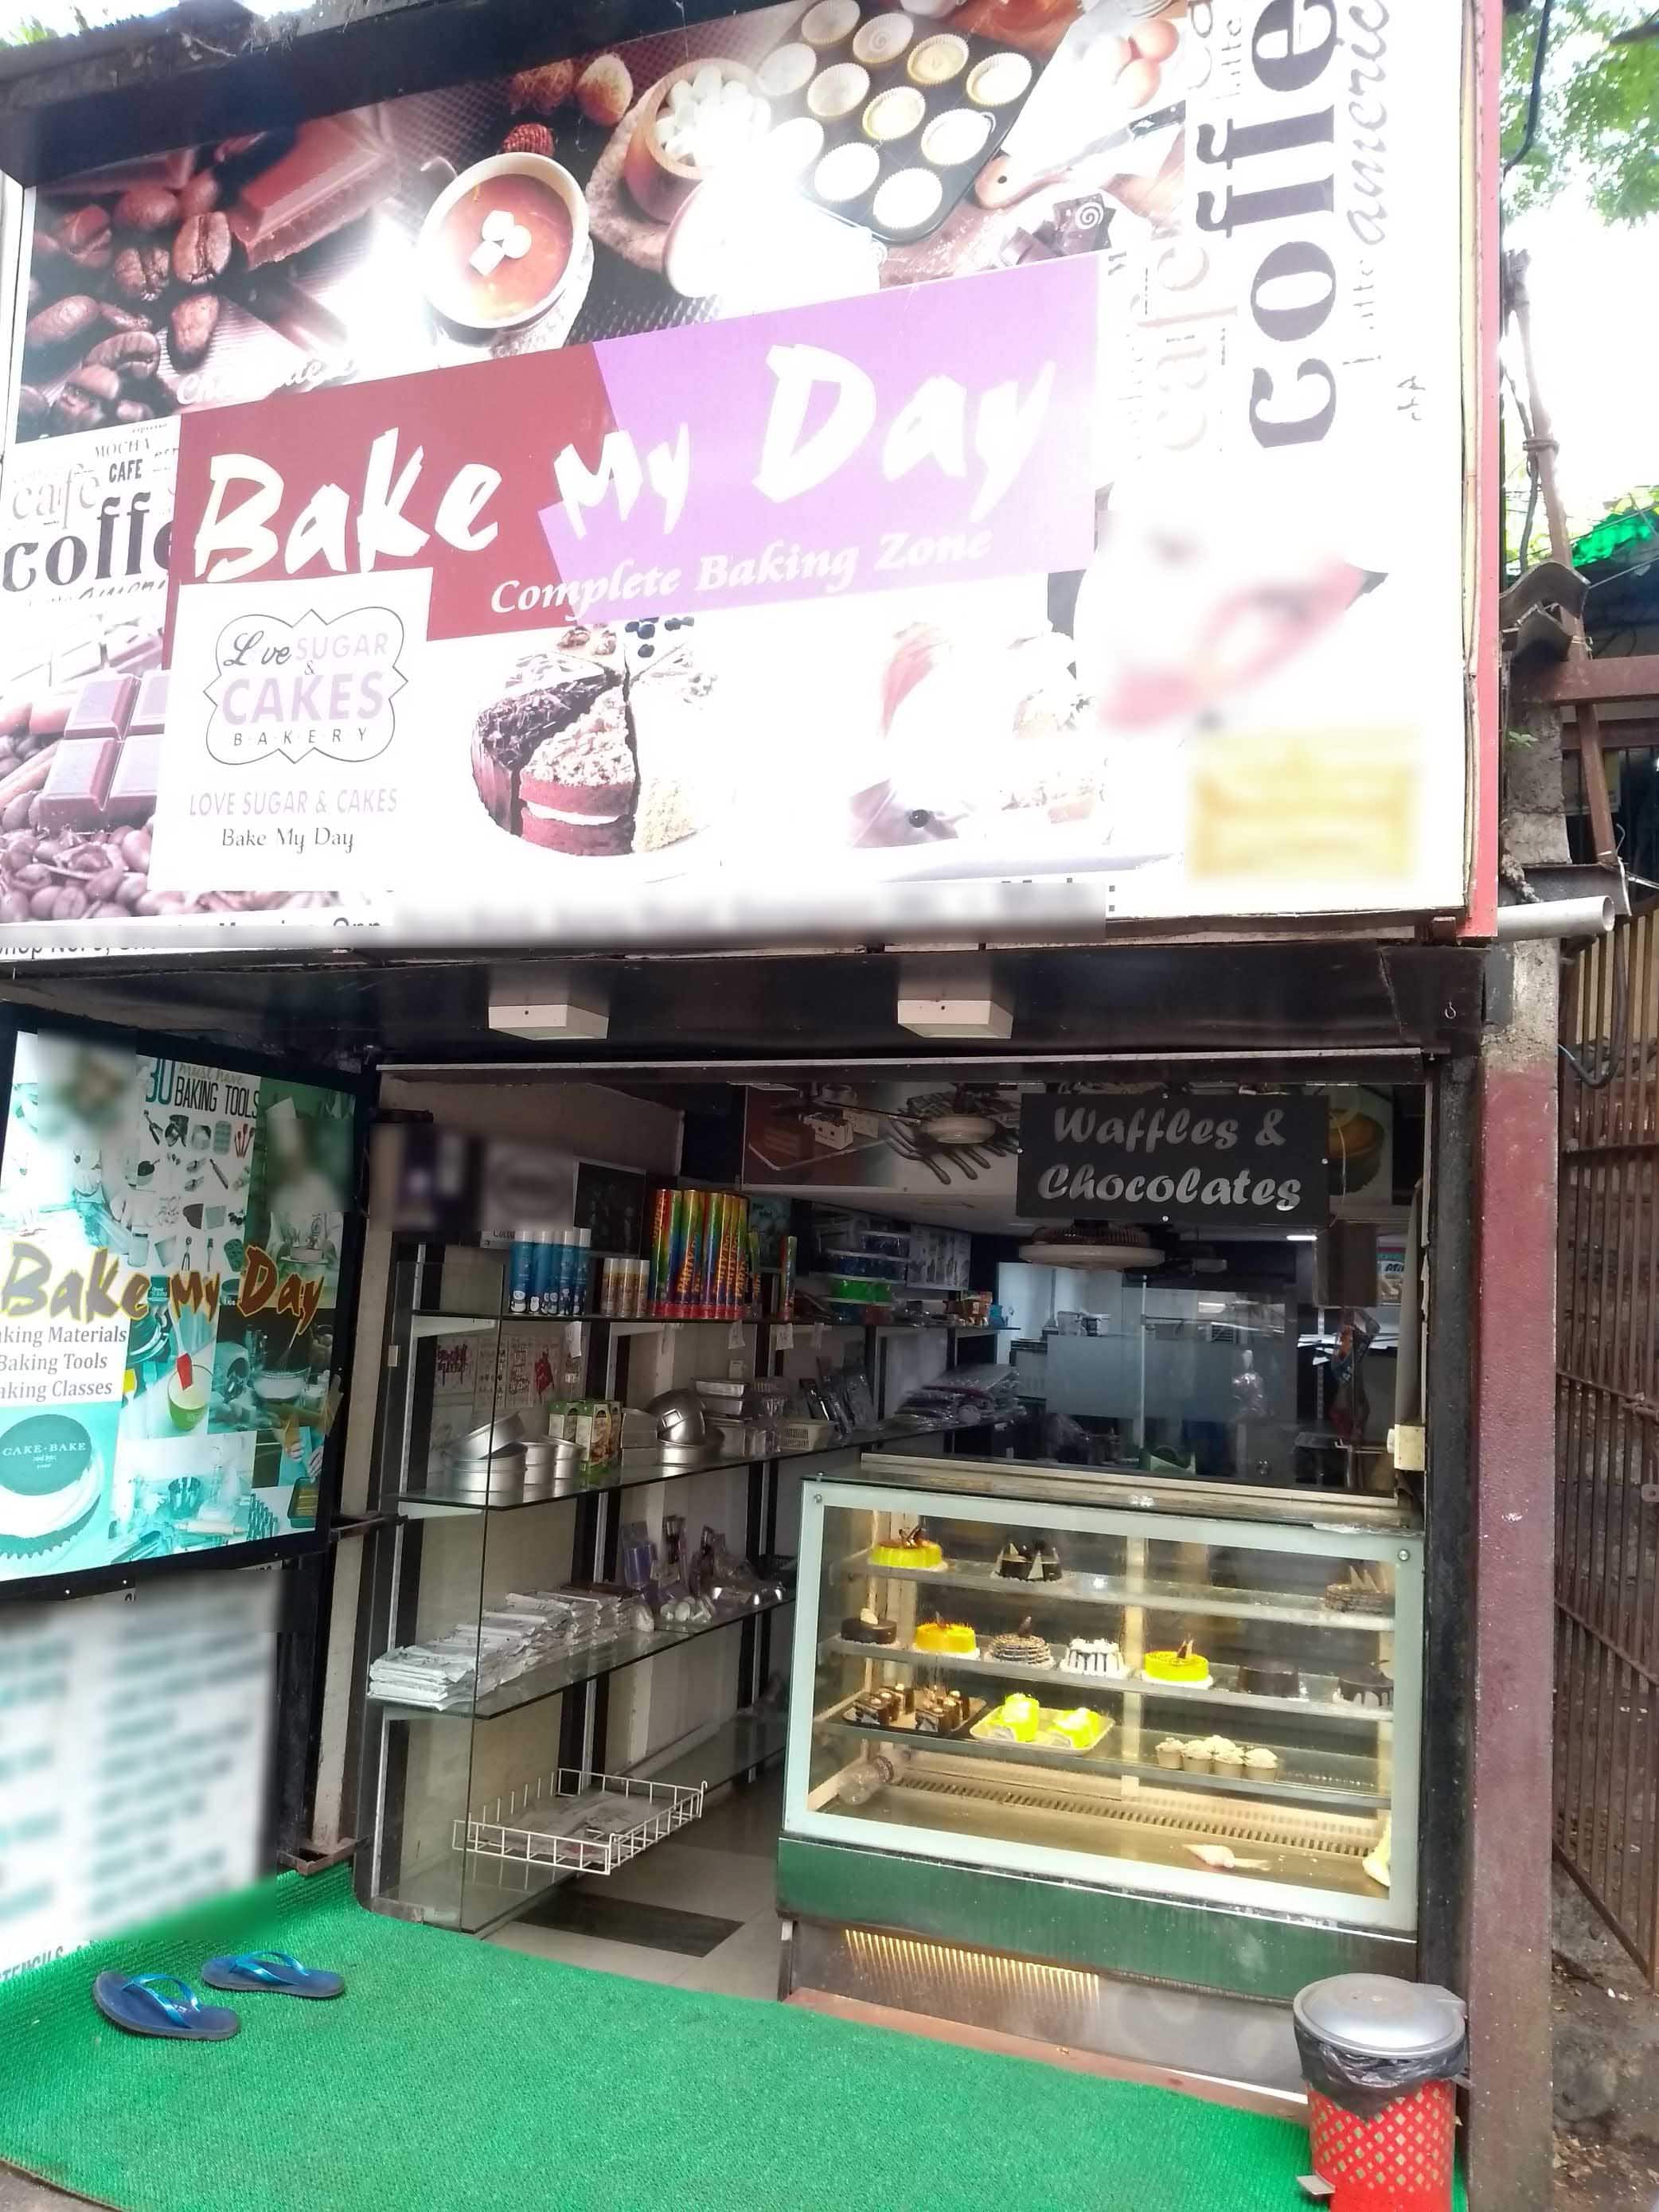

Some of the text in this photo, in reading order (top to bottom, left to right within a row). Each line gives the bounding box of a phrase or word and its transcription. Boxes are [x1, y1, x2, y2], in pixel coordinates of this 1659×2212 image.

[109, 458, 143, 483] CAFE
[193, 427, 502, 582] Bake
[553, 423, 690, 540] My
[751, 343, 1056, 524] Day
[490, 528, 993, 621] Complete Baking Zone
[223, 630, 388, 666] Lve SUGAR
[304, 660, 315, 675] &
[222, 671, 384, 725] CAKES
[189, 788, 397, 816] LOVE SUGAR & CAKES
[222, 827, 353, 854] Bake My Day
[174, 1075, 260, 1119] BAKING TOOLS
[1053, 1107, 1286, 1153] Waffles &
[1037, 1162, 1302, 1211] Chocolates
[0, 1241, 325, 1336] Bake My Day
[0, 1326, 127, 1348] king Materials
[0, 1352, 108, 1375] Baking Tools
[53, 1380, 113, 1398] Classes
[49, 1442, 86, 1453] BAKE
